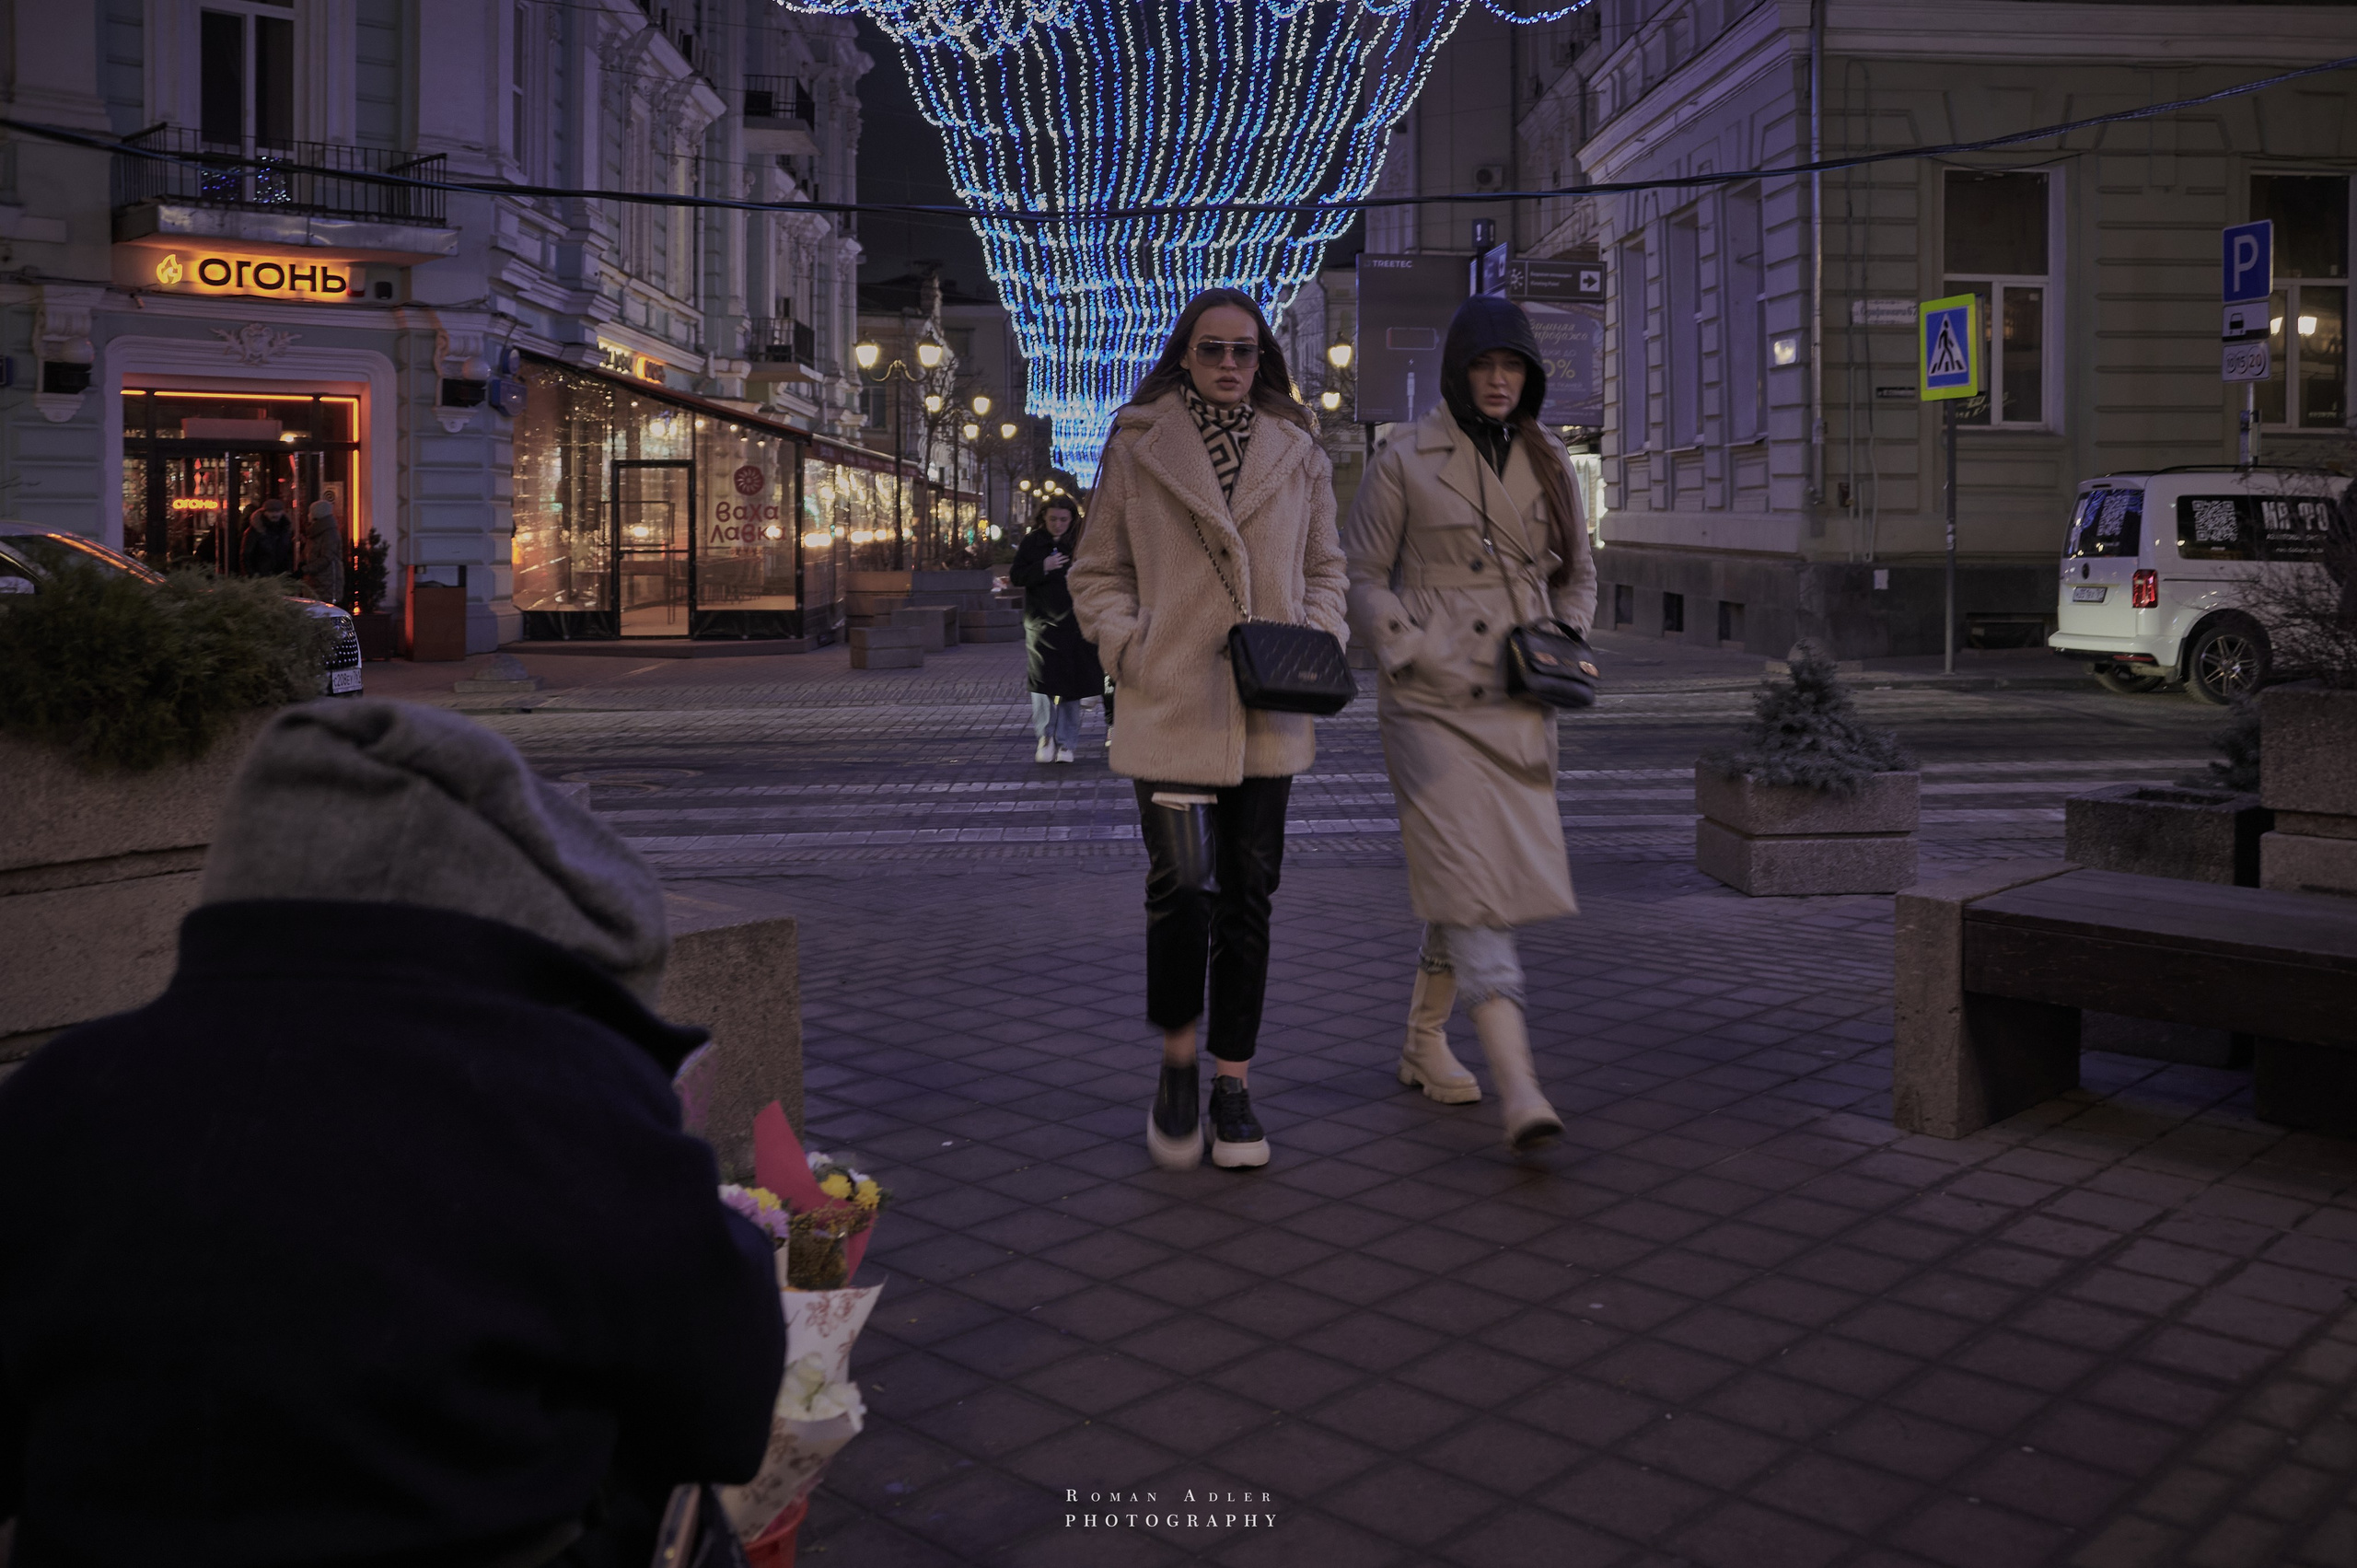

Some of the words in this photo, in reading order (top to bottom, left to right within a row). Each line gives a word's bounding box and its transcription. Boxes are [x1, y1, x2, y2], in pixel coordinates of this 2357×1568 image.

[1373, 260, 1413, 268] TREETEC
[2234, 234, 2258, 293] P
[198, 258, 347, 293] ОГОНЬ
[1534, 331, 1589, 345] продажа
[2249, 354, 2261, 367] 20
